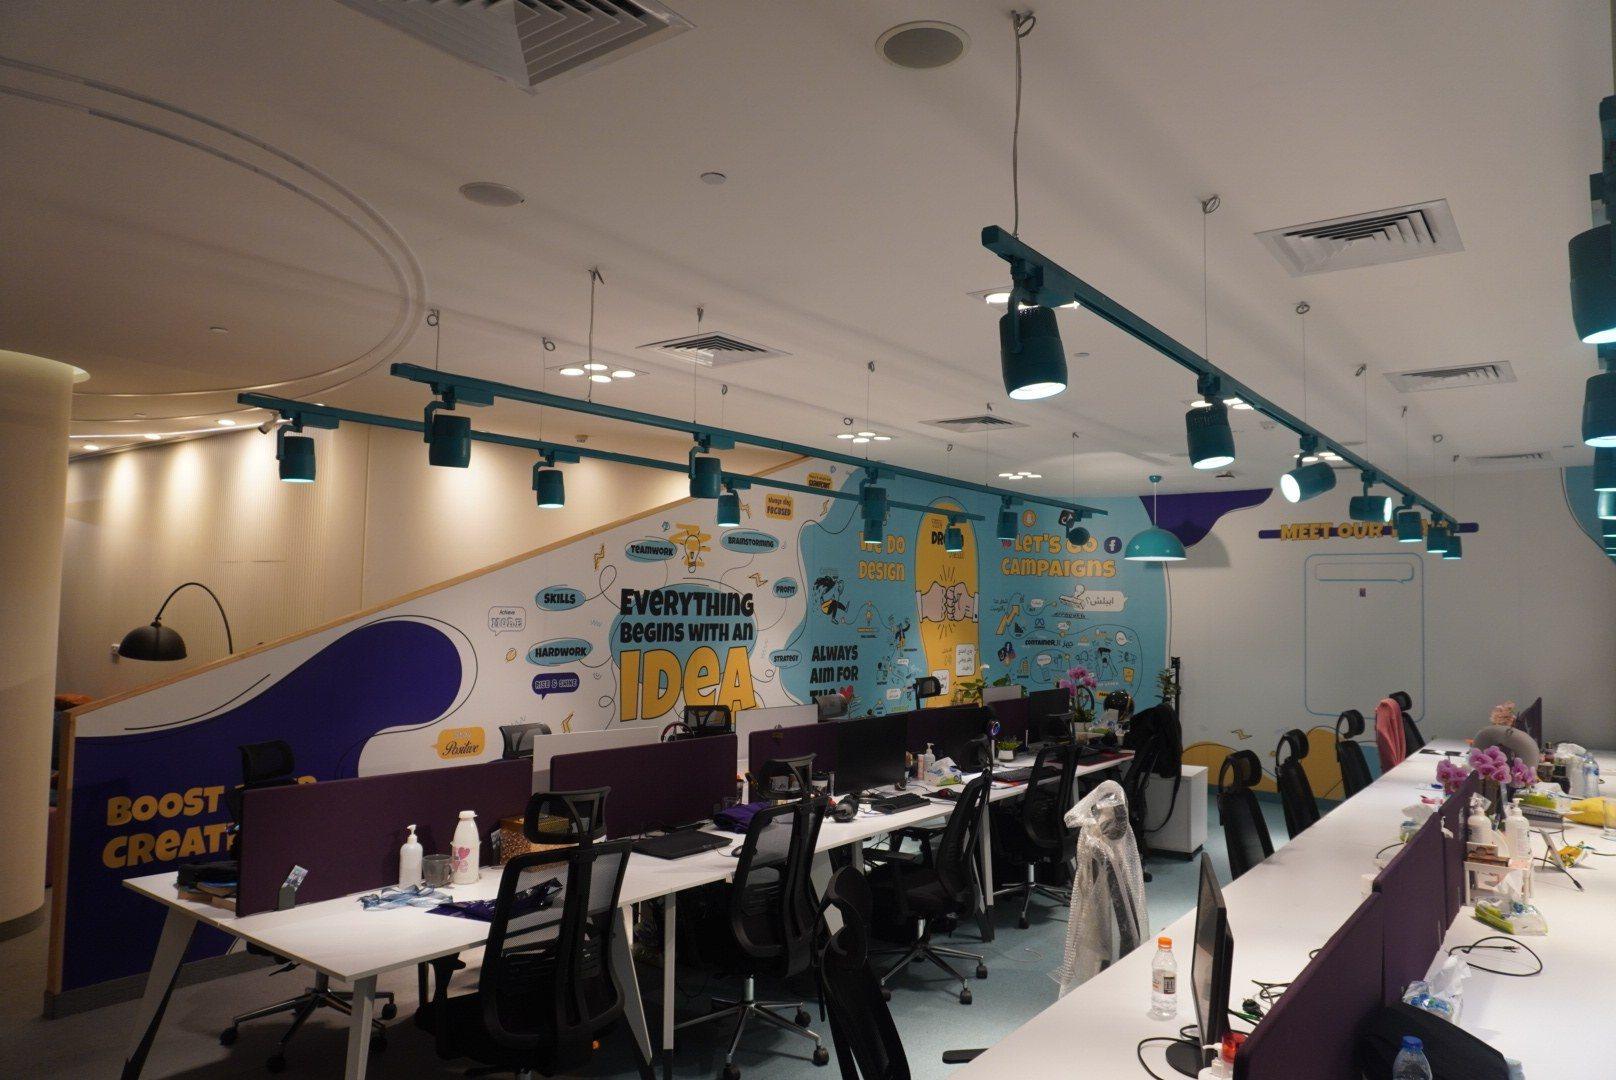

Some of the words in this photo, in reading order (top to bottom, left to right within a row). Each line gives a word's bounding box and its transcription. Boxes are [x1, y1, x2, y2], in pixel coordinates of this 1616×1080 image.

[767, 506, 792, 516] FOCUSED
[1280, 523, 1333, 541] MEET
[1337, 521, 1385, 539] OUR
[630, 544, 674, 556] TEAMWORK
[727, 536, 774, 548] BRAINSTORMING
[887, 535, 905, 554] DO
[1014, 533, 1062, 554] LET'S
[858, 560, 905, 581] DESIGN
[1000, 557, 1116, 578] CAMPAIGNS
[543, 593, 576, 604] SKILLS
[775, 585, 796, 594] PROFIT
[619, 588, 755, 617] EVERYTHING
[619, 622, 685, 643] BEGINS
[688, 623, 730, 642] WITH
[731, 623, 754, 641] AN
[535, 647, 587, 658] HARDWORK
[773, 654, 799, 663] STRATEGY
[811, 645, 859, 662] ALWAYS
[619, 646, 757, 722] IDEA
[810, 666, 835, 684] AIM
[837, 666, 859, 682] FOR
[442, 741, 480, 756] Positive
[106, 785, 225, 827] BOOST
